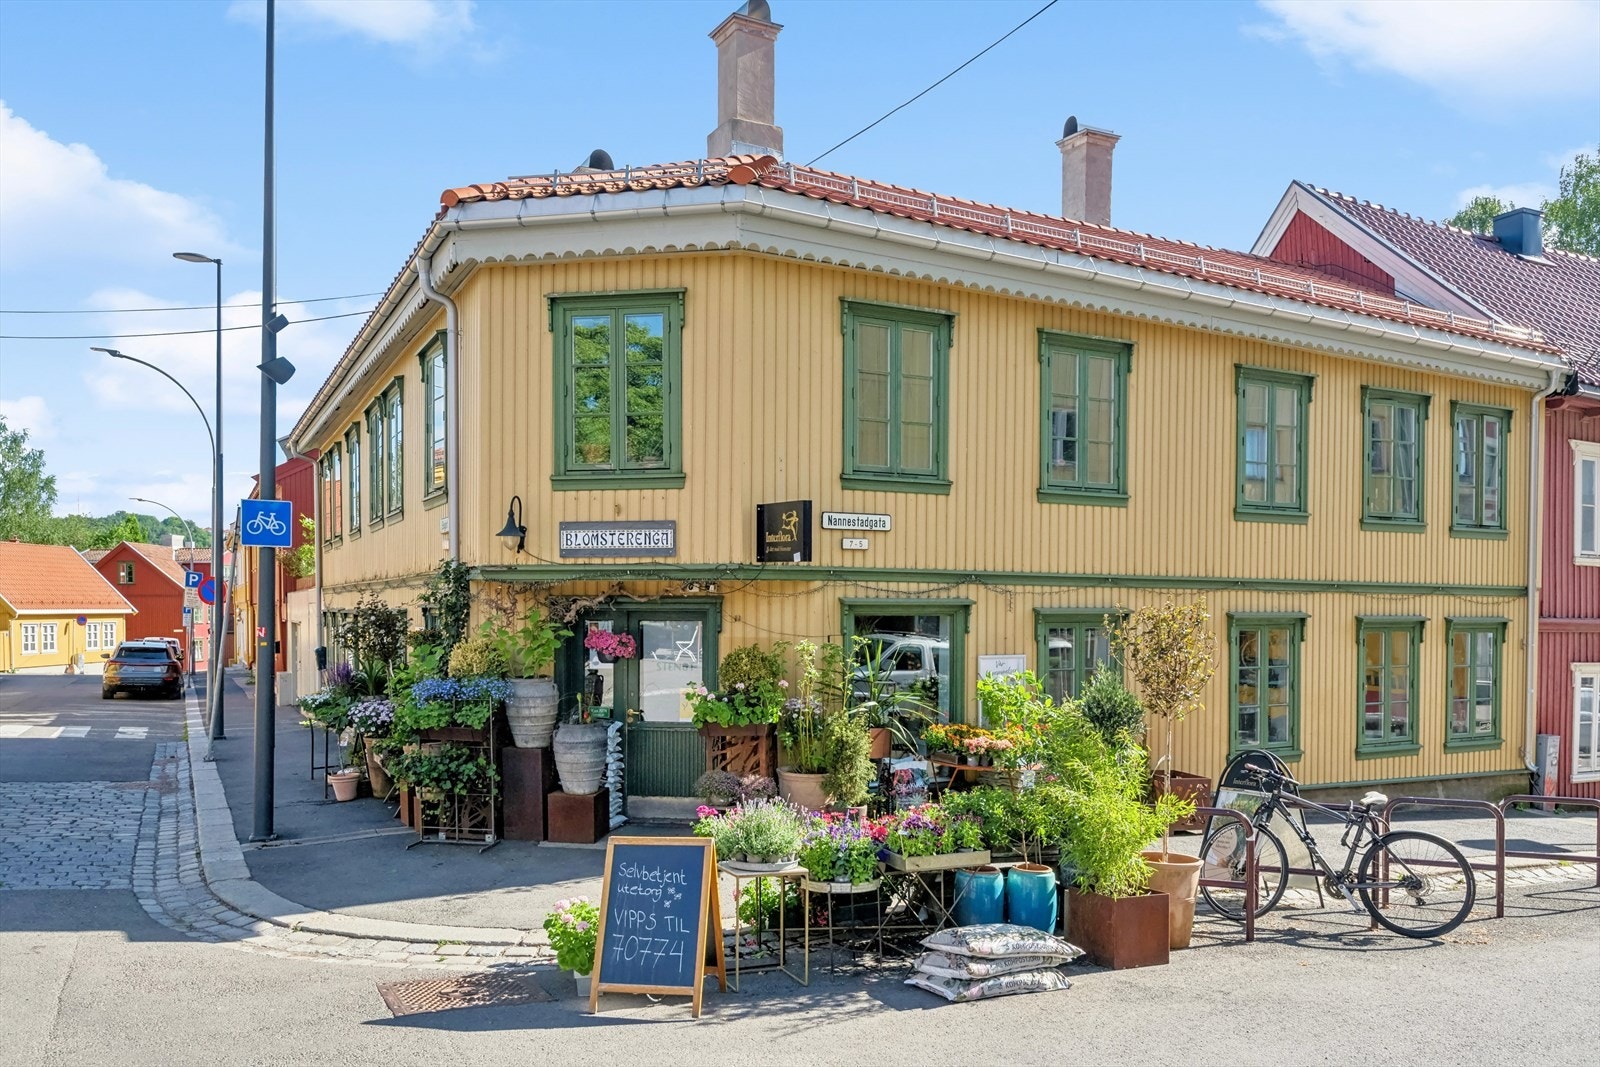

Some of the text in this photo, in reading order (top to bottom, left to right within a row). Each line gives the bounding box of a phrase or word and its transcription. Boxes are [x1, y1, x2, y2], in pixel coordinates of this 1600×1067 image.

[827, 514, 887, 530] Nannestadgata
[565, 531, 669, 546] BLOMSTERENGA
[765, 530, 792, 543] Interflora
[188, 573, 199, 586] P
[618, 861, 688, 888] Selvbetjent
[617, 882, 662, 903] utetorg
[614, 908, 690, 933] VIPPS TIL
[612, 933, 684, 973] 70774
